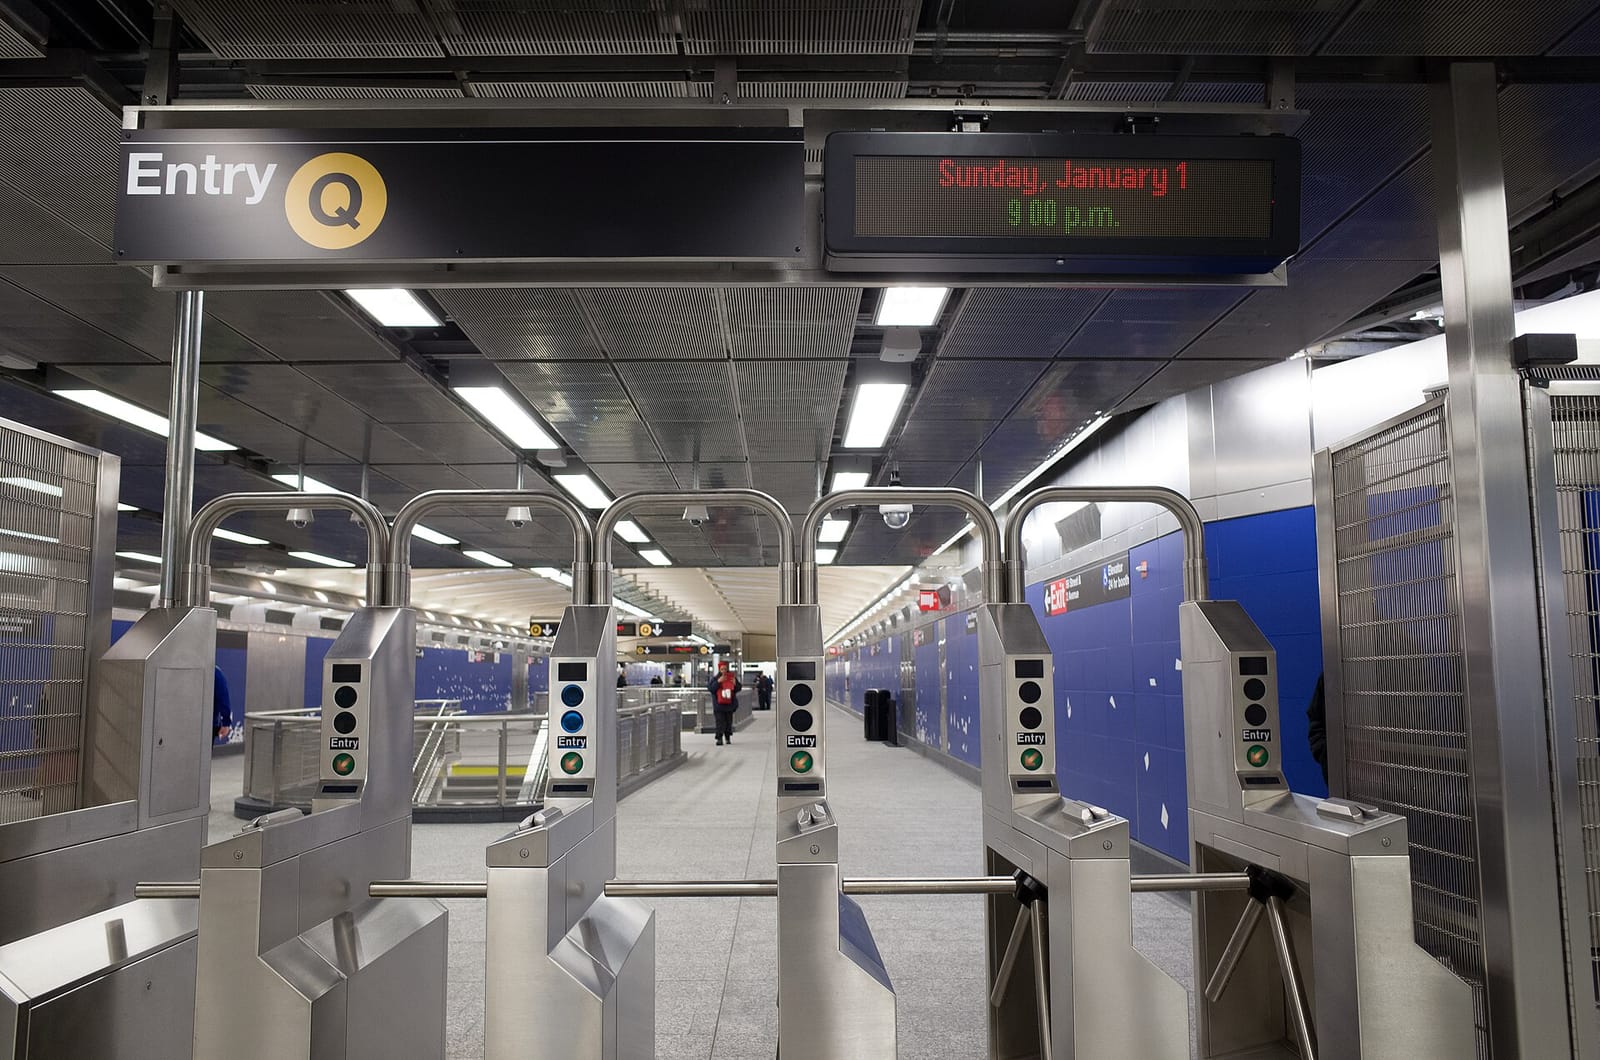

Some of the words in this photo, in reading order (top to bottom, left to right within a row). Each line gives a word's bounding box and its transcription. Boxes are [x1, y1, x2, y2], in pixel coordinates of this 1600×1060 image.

[939, 159, 1047, 195] Sunday,
[1056, 160, 1167, 196] January
[1176, 161, 1188, 189] 1
[126, 152, 278, 205] Entry
[308, 172, 362, 230] Q
[1065, 206, 1120, 234] p.m.
[1050, 581, 1066, 610] Exit
[558, 736, 586, 748] Entry
[787, 736, 816, 747] Entry
[1017, 733, 1045, 745] Entry
[1243, 730, 1270, 742] Entry
[331, 738, 359, 749] Entry
